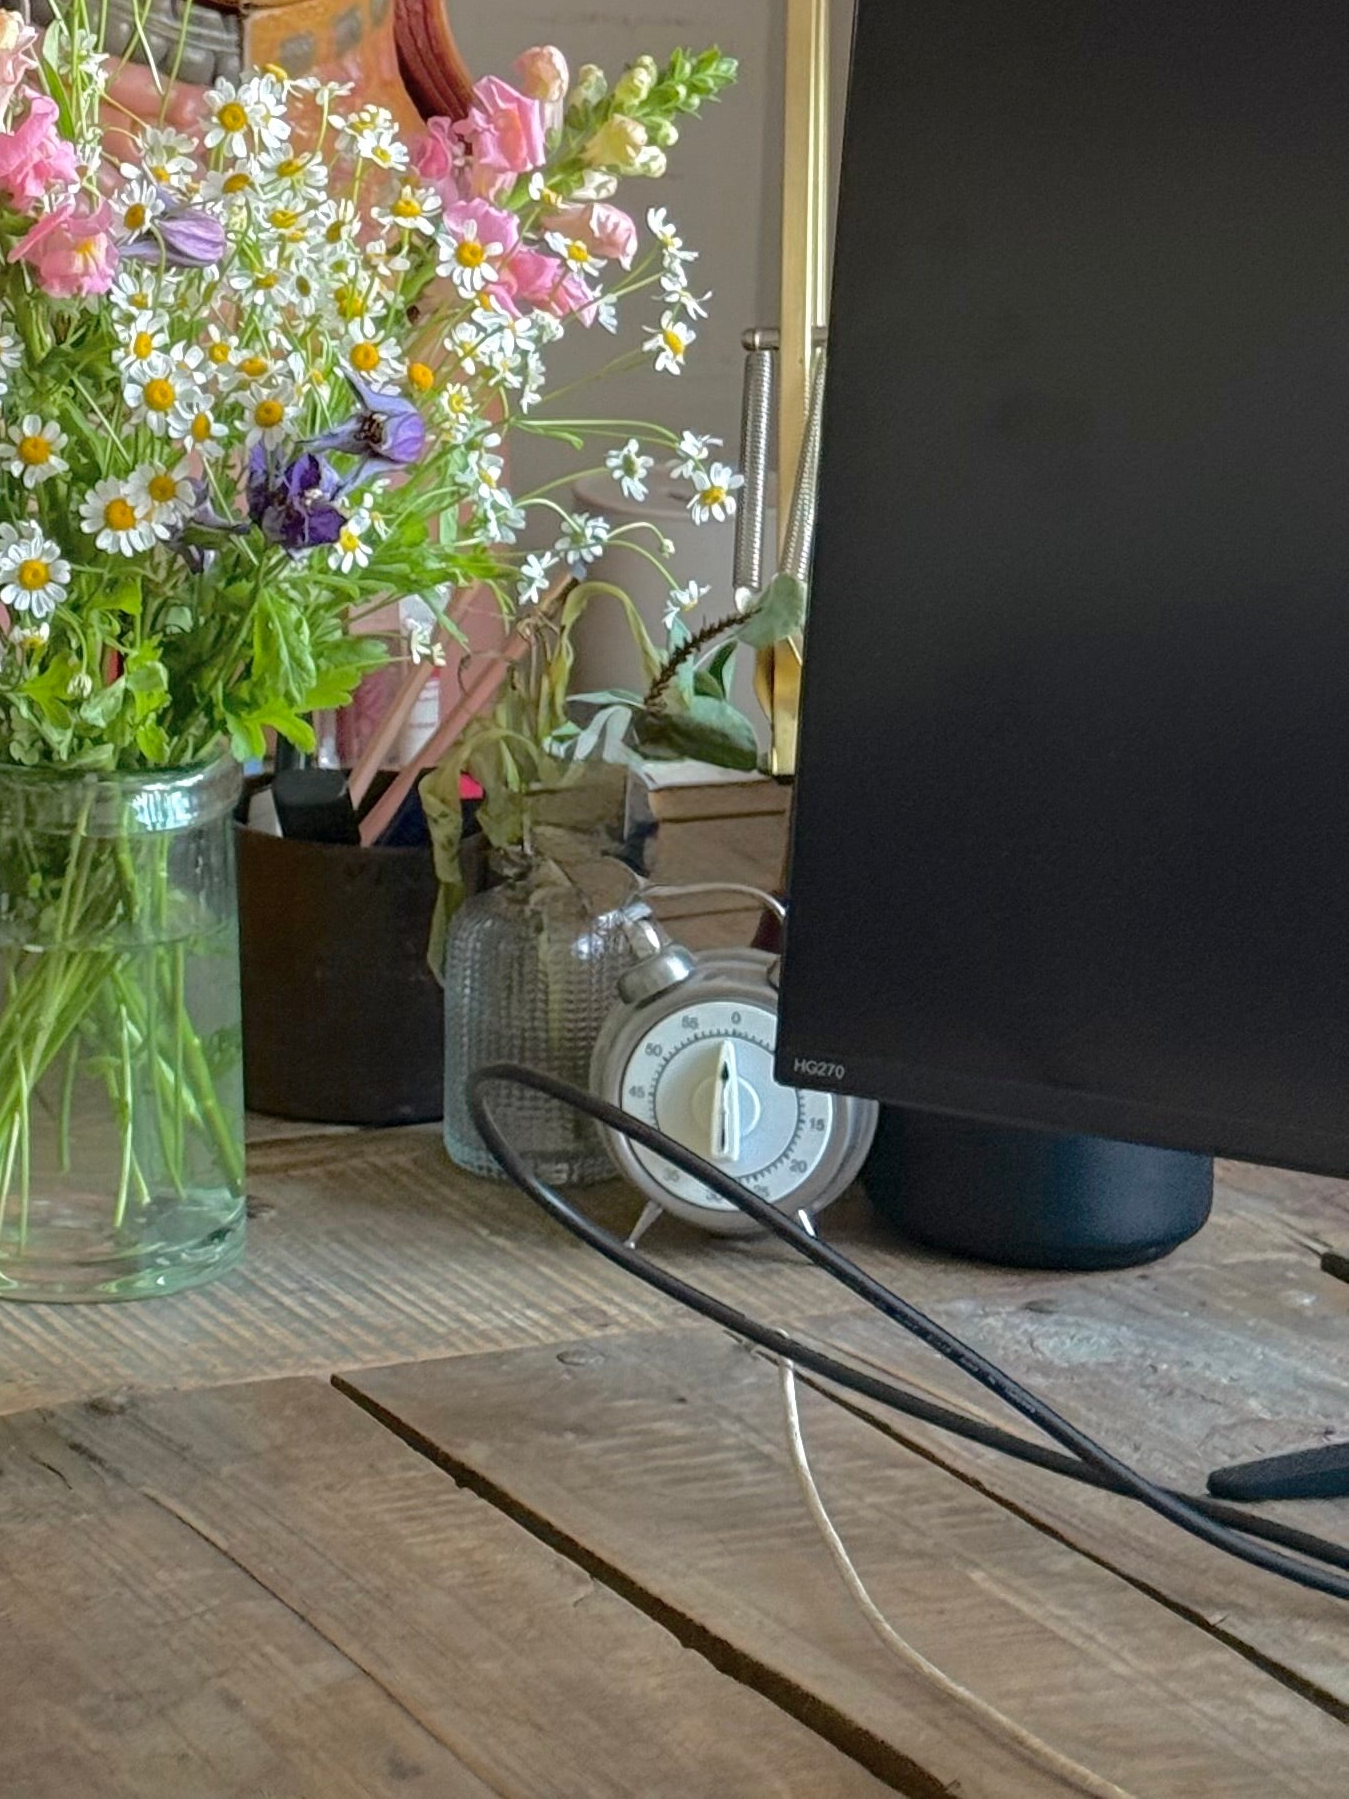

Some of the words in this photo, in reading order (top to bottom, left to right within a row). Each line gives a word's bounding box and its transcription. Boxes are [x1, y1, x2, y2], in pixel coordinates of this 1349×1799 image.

[681, 1014, 700, 1030] 55
[730, 1011, 742, 1024] 0
[644, 1042, 663, 1058] 50
[793, 1057, 846, 1081] HG270
[628, 1085, 646, 1099] 45
[809, 1117, 826, 1132] 15
[789, 1158, 808, 1175] 20
